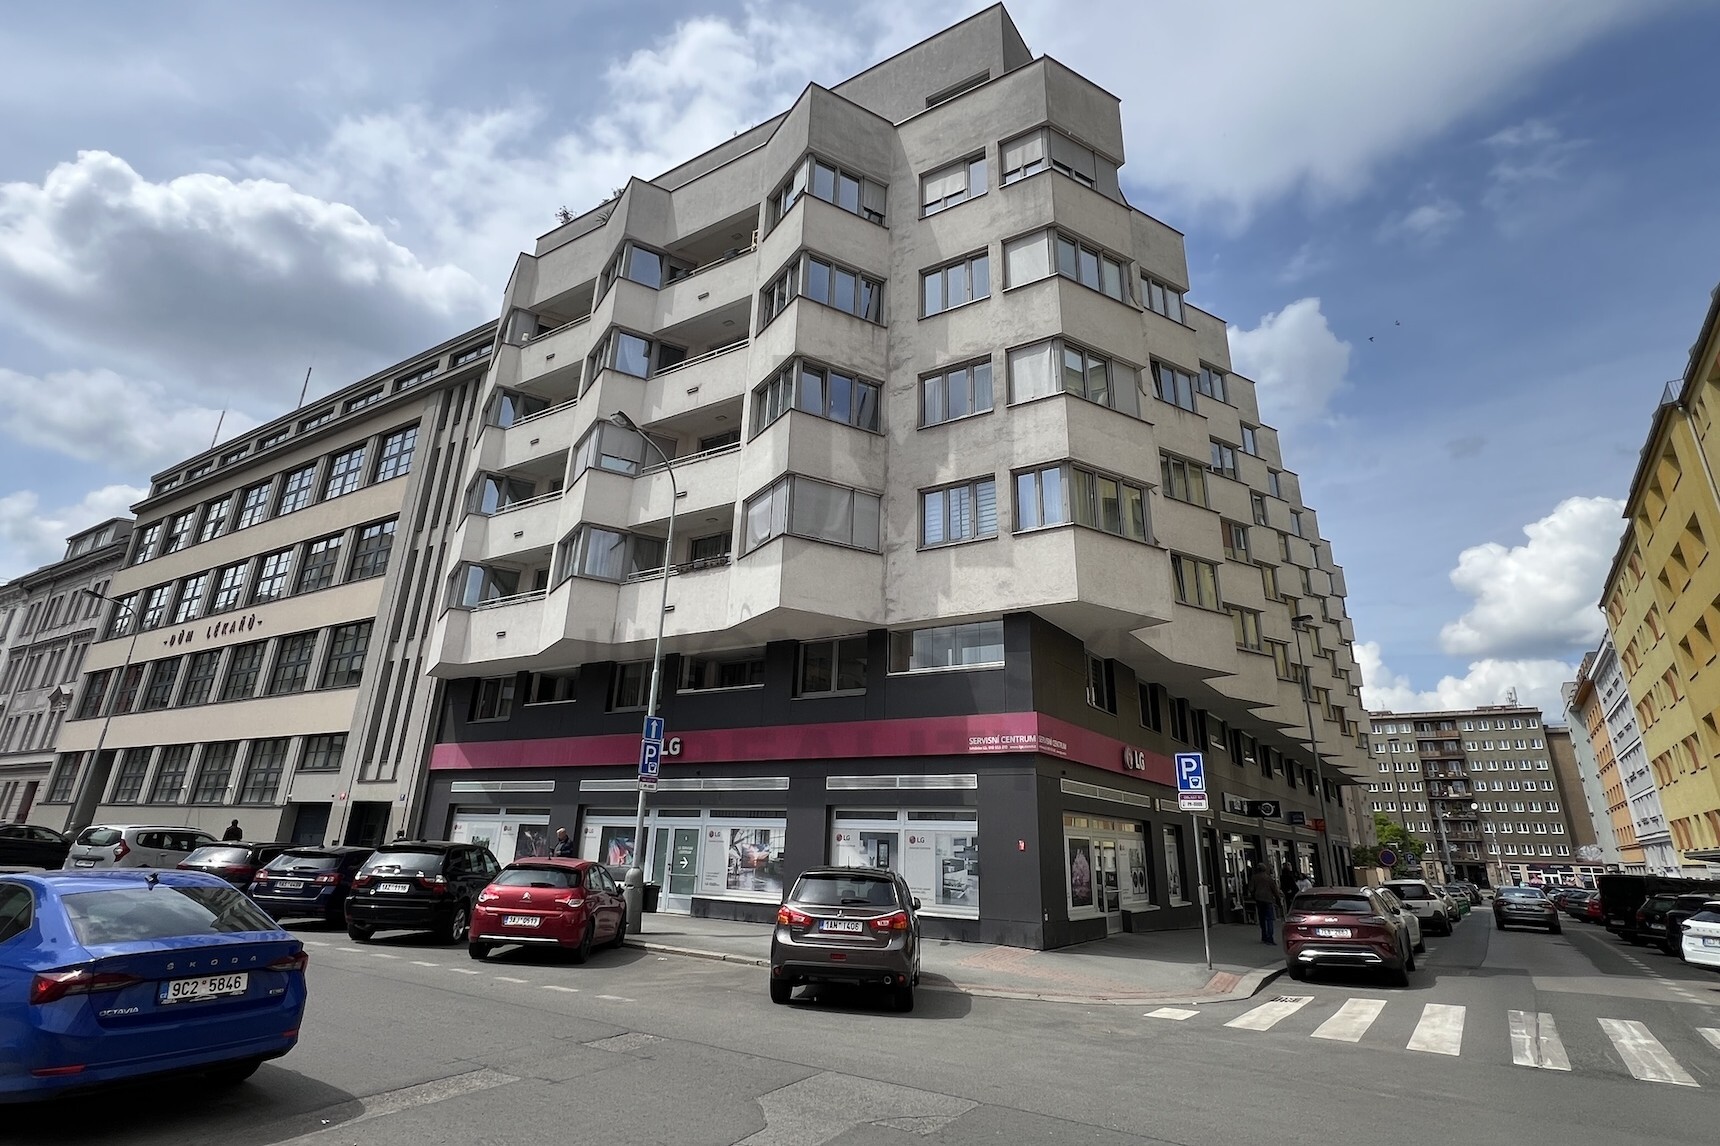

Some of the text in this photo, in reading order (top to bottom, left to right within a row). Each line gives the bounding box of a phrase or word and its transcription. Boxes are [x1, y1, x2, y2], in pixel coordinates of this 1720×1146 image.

[660, 737, 681, 755] LG
[968, 734, 1037, 745] SERVISNÍ CENTRUM
[645, 745, 656, 764] P
[1134, 749, 1146, 771] LG
[1181, 758, 1197, 780] P
[171, 975, 242, 997] 9C2 5846
[99, 1007, 139, 1016] OCTAVIA
